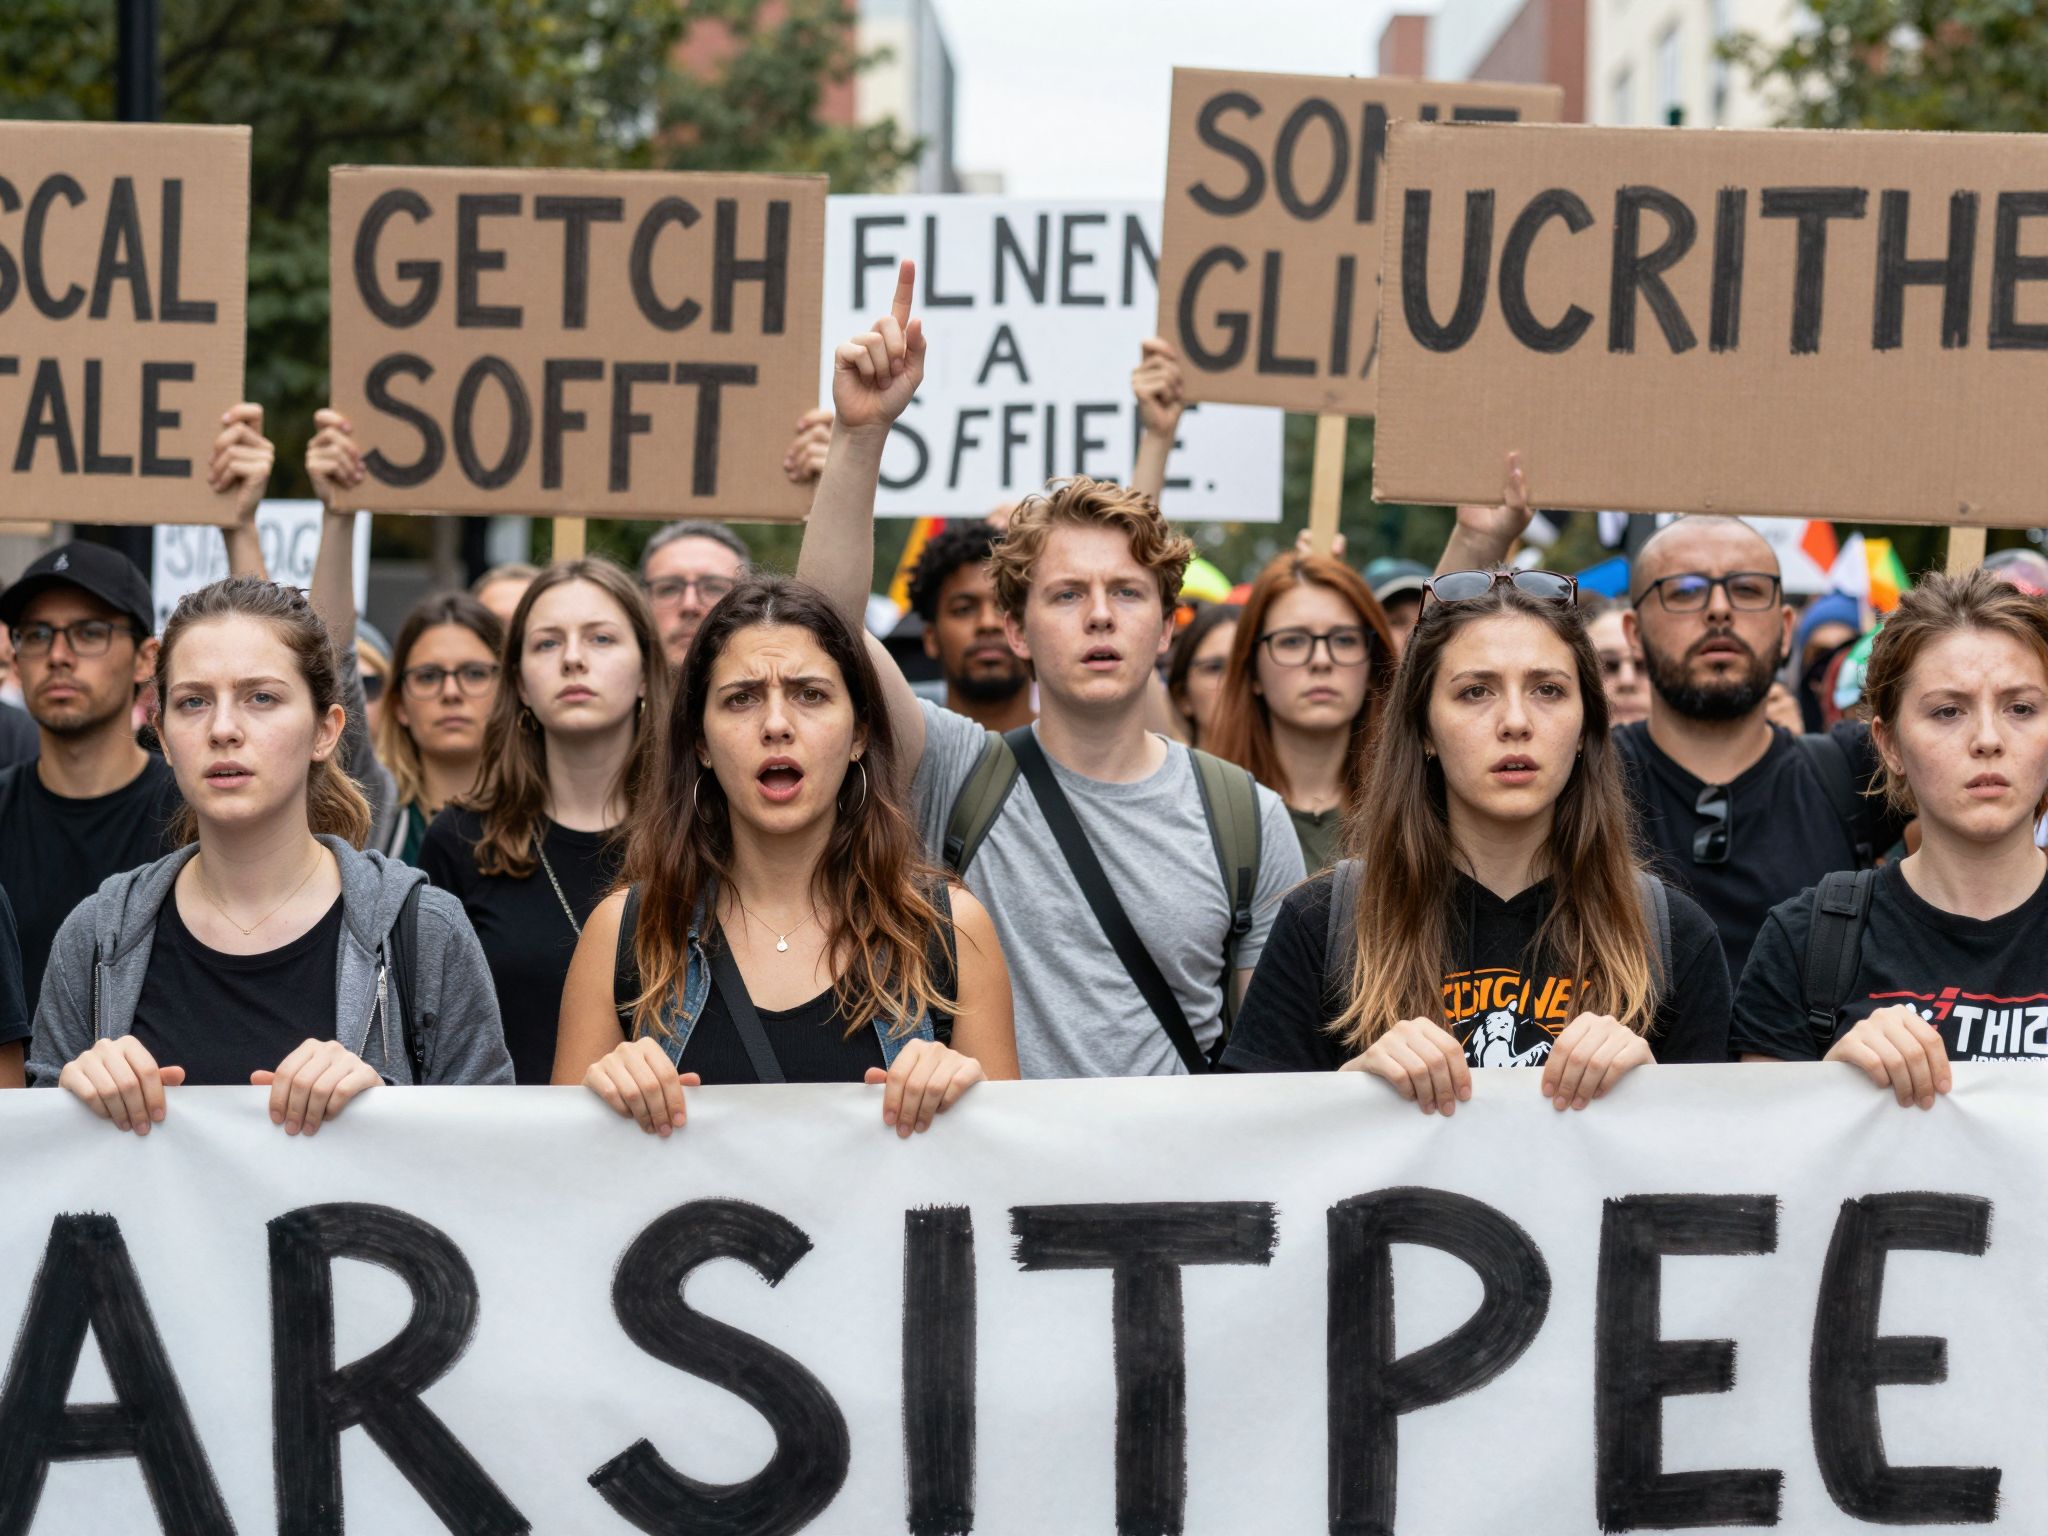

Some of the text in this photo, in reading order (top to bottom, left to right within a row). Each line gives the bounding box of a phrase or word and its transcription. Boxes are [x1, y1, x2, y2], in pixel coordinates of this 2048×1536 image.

[354, 188, 791, 335] GETCH
[1178, 245, 1382, 380] GLI
[1402, 185, 2048, 355] UCRITHE
[363, 352, 758, 497] SOFFT
[976, 323, 1031, 385] A
[0, 1186, 2003, 1536] ARSITPEE
